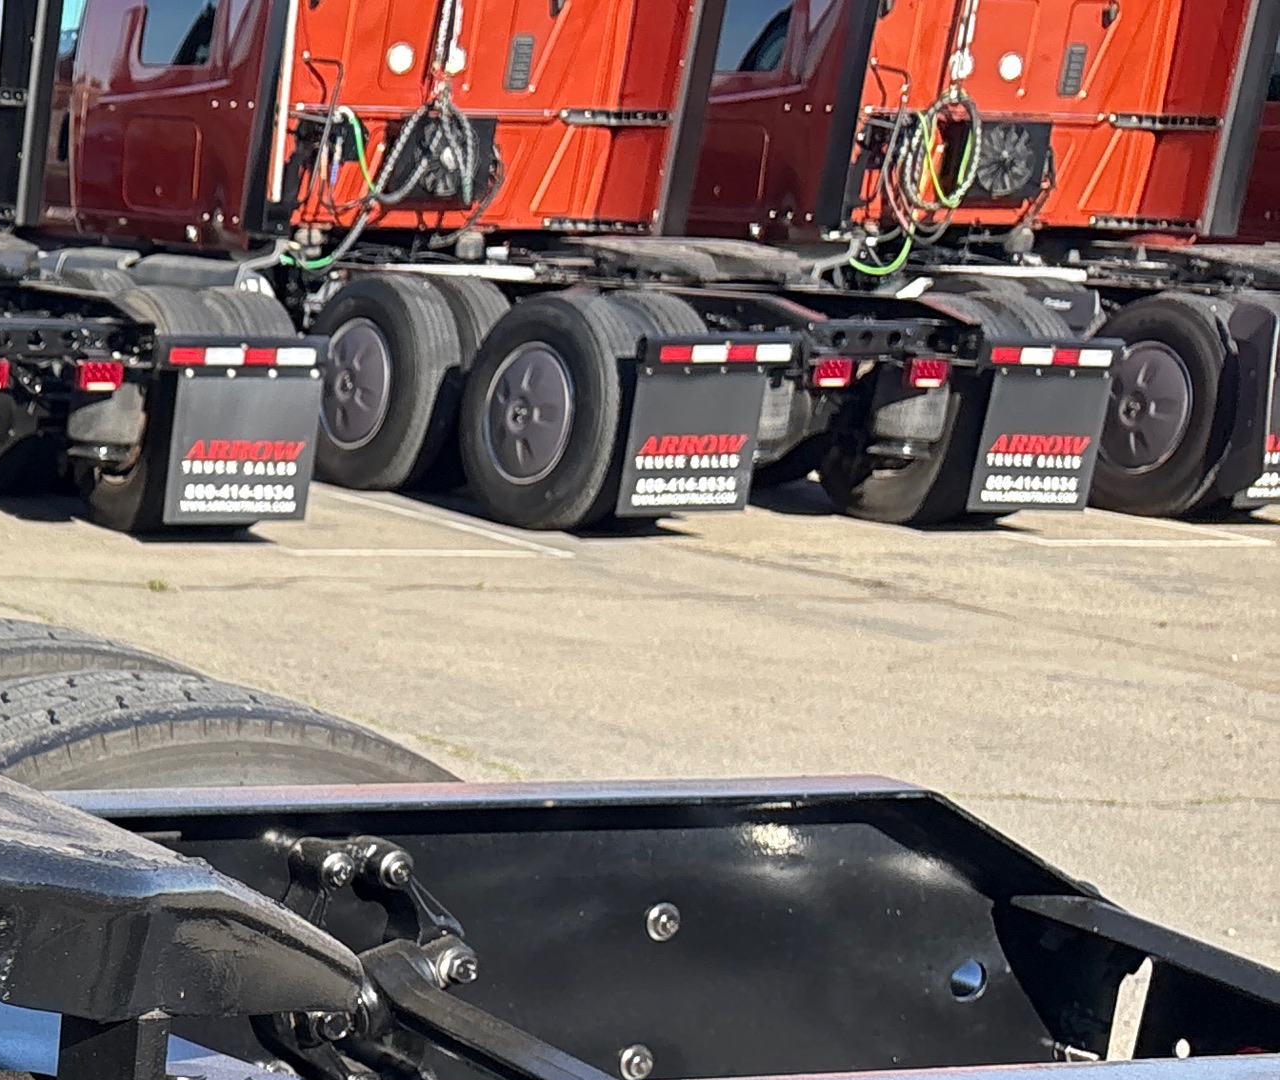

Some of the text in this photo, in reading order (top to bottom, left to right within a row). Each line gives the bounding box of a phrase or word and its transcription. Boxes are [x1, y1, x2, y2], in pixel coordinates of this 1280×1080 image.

[184, 439, 306, 461] ARROW
[637, 434, 749, 455] ARROW
[989, 434, 1091, 455] ARROW
[181, 460, 297, 476] TRUCK SALES
[635, 454, 740, 470] TRUCK SALES
[986, 453, 1082, 469] TRUCK SALES
